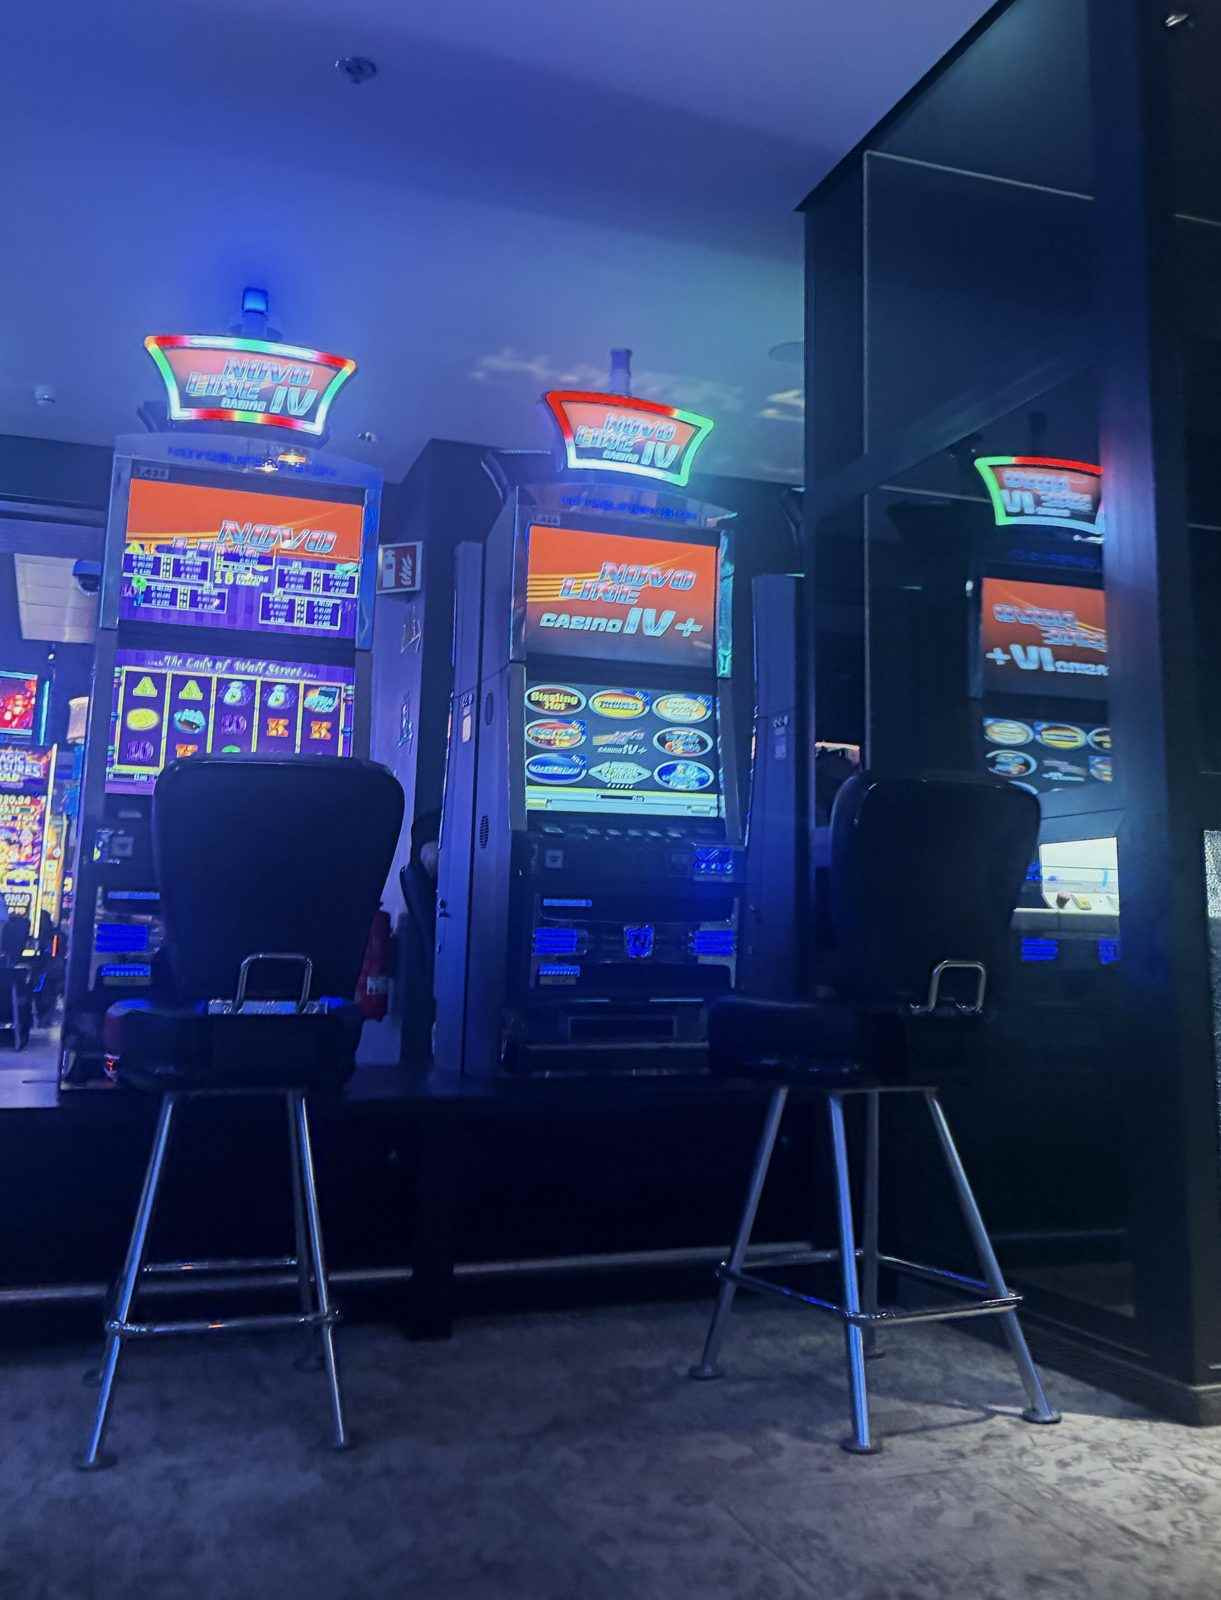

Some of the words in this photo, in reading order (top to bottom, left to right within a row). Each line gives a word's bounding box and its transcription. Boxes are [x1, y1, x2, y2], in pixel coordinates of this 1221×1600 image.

[268, 385, 320, 417] IV
[641, 441, 681, 468] IV
[217, 519, 337, 553] NOVO
[559, 577, 641, 605] LINE
[600, 561, 697, 591] NOVO
[540, 612, 624, 633] CASINO
[622, 606, 677, 638] IV
[215, 659, 231, 672] of
[233, 660, 266, 674] Wall
